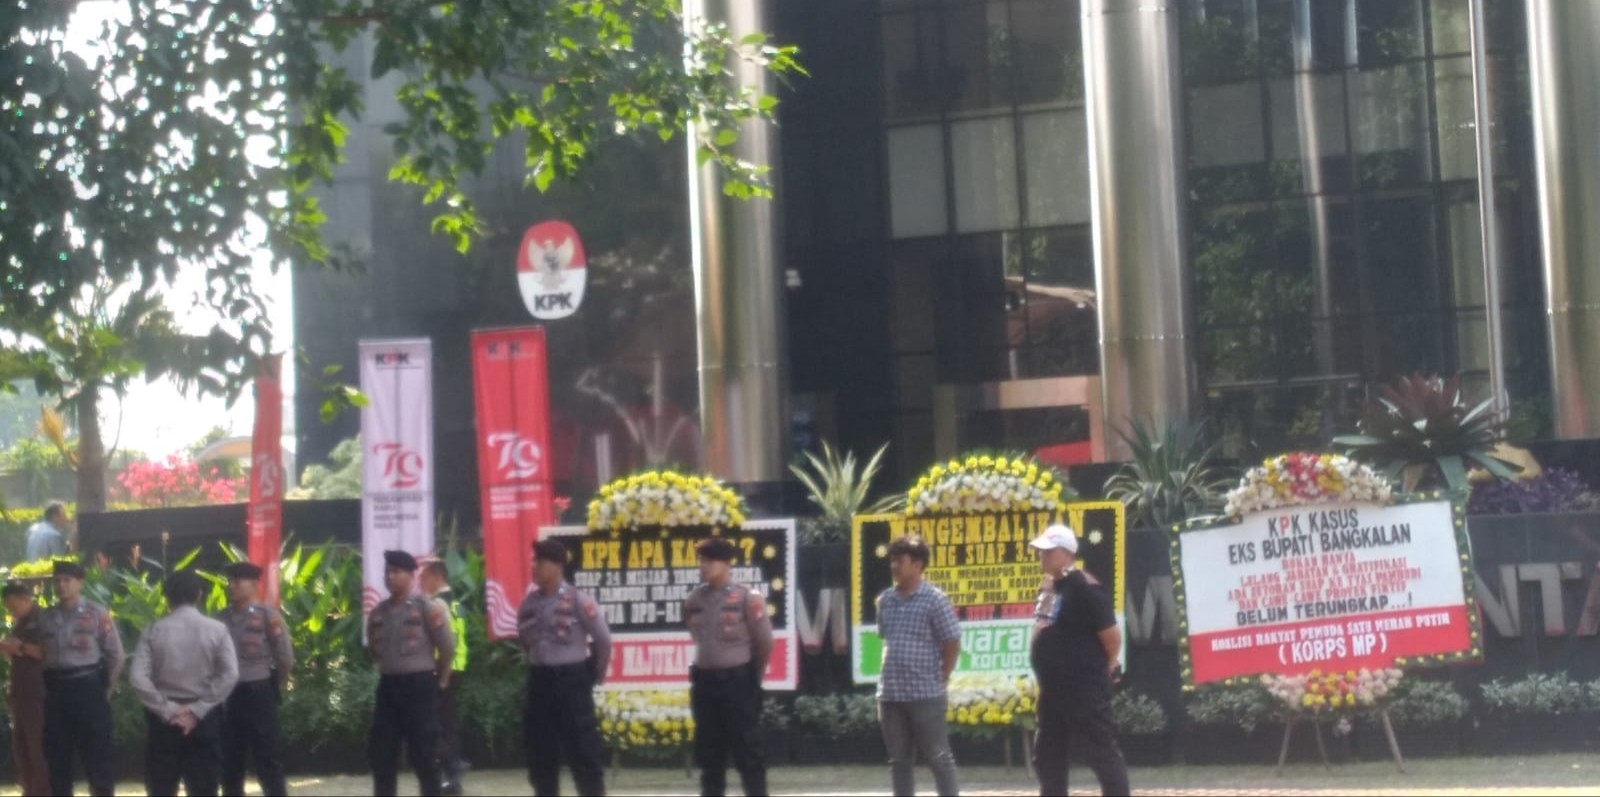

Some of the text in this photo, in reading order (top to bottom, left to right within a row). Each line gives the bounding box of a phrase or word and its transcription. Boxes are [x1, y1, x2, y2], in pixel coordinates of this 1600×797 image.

[534, 292, 574, 312] KPK
[375, 353, 410, 366] KPK
[373, 442, 424, 489] 79
[487, 432, 541, 480] 79
[891, 508, 1084, 546] MENGEMBALIKN
[1268, 508, 1359, 538] KPK KASUS
[582, 541, 621, 570] KPK
[628, 540, 665, 569] APA
[966, 542, 1006, 565] SUAP
[1228, 523, 1411, 565] EKS BUPATI BANGKALAN
[673, 569, 701, 585] YANG
[1009, 576, 1040, 589] KORUP
[1236, 606, 1288, 626] BELUM
[1255, 629, 1297, 647] RAKYAT
[1300, 624, 1344, 641] PEMUDA
[1347, 620, 1372, 636] SATU
[1375, 616, 1412, 632] MERAH
[1416, 612, 1450, 628] PUTIH
